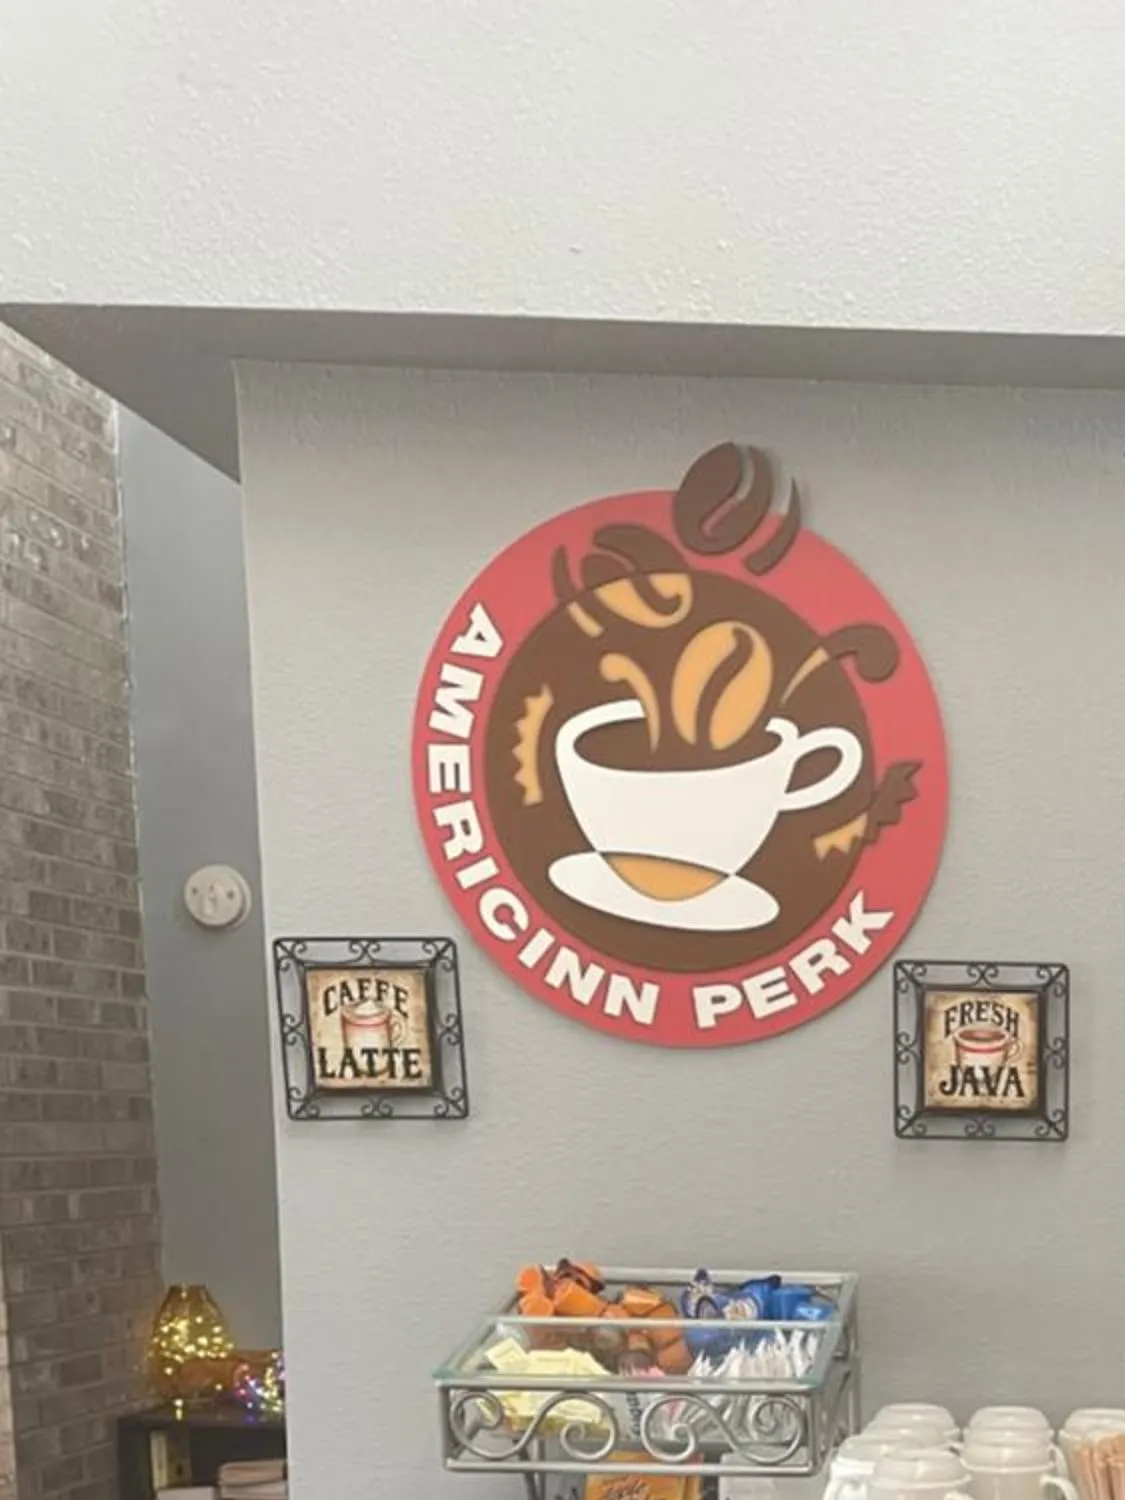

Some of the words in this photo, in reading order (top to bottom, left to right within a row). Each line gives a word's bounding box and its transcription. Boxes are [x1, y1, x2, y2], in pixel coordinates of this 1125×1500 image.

[427, 603, 660, 1026] AMERICINN
[692, 889, 895, 1029] PERK
[944, 1001, 1020, 1040] FRESH
[317, 1047, 423, 1079] LATTE
[938, 1065, 1025, 1097] JAVA
